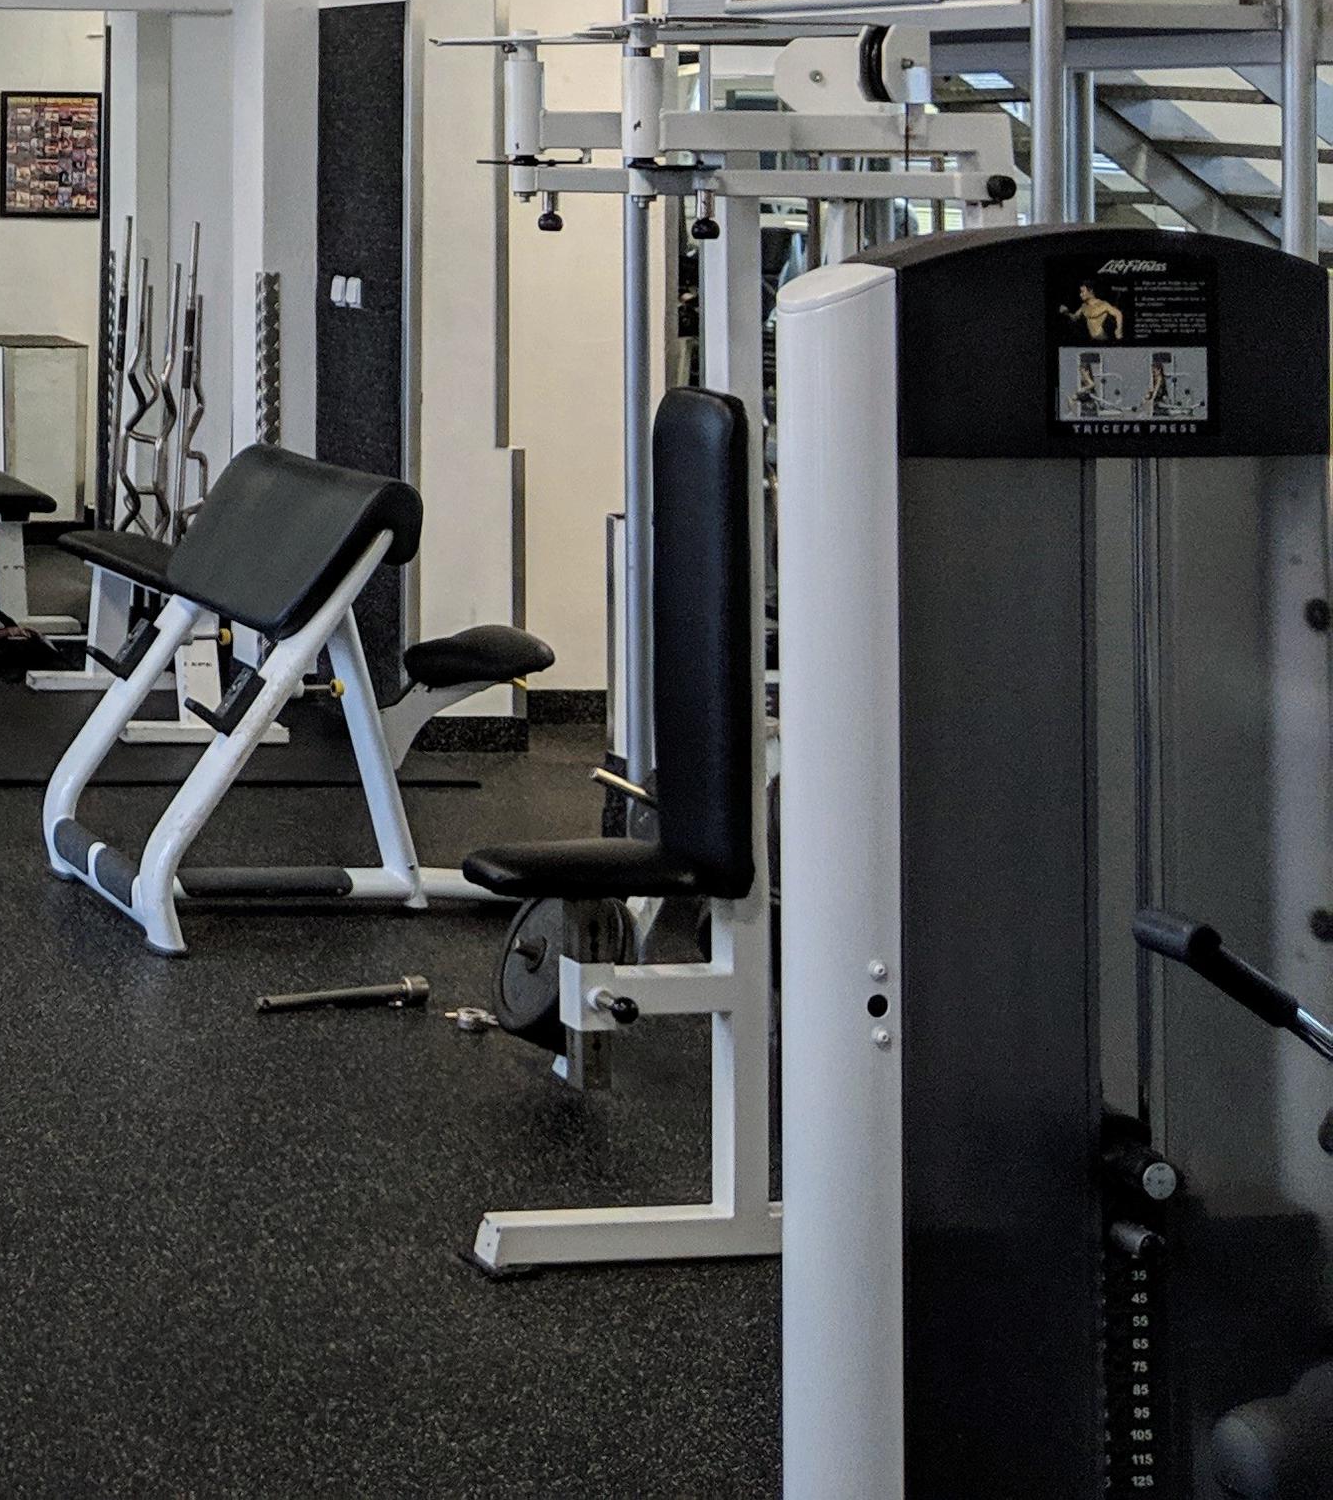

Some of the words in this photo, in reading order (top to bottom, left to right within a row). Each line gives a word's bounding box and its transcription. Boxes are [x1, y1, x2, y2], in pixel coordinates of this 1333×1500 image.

[1131, 1292, 1148, 1304] 45
[1132, 1361, 1148, 1372] 75
[1133, 1384, 1149, 1395] 85
[1133, 1407, 1150, 1418] 95
[1130, 1429, 1153, 1441] 105
[1131, 1453, 1153, 1465] 115
